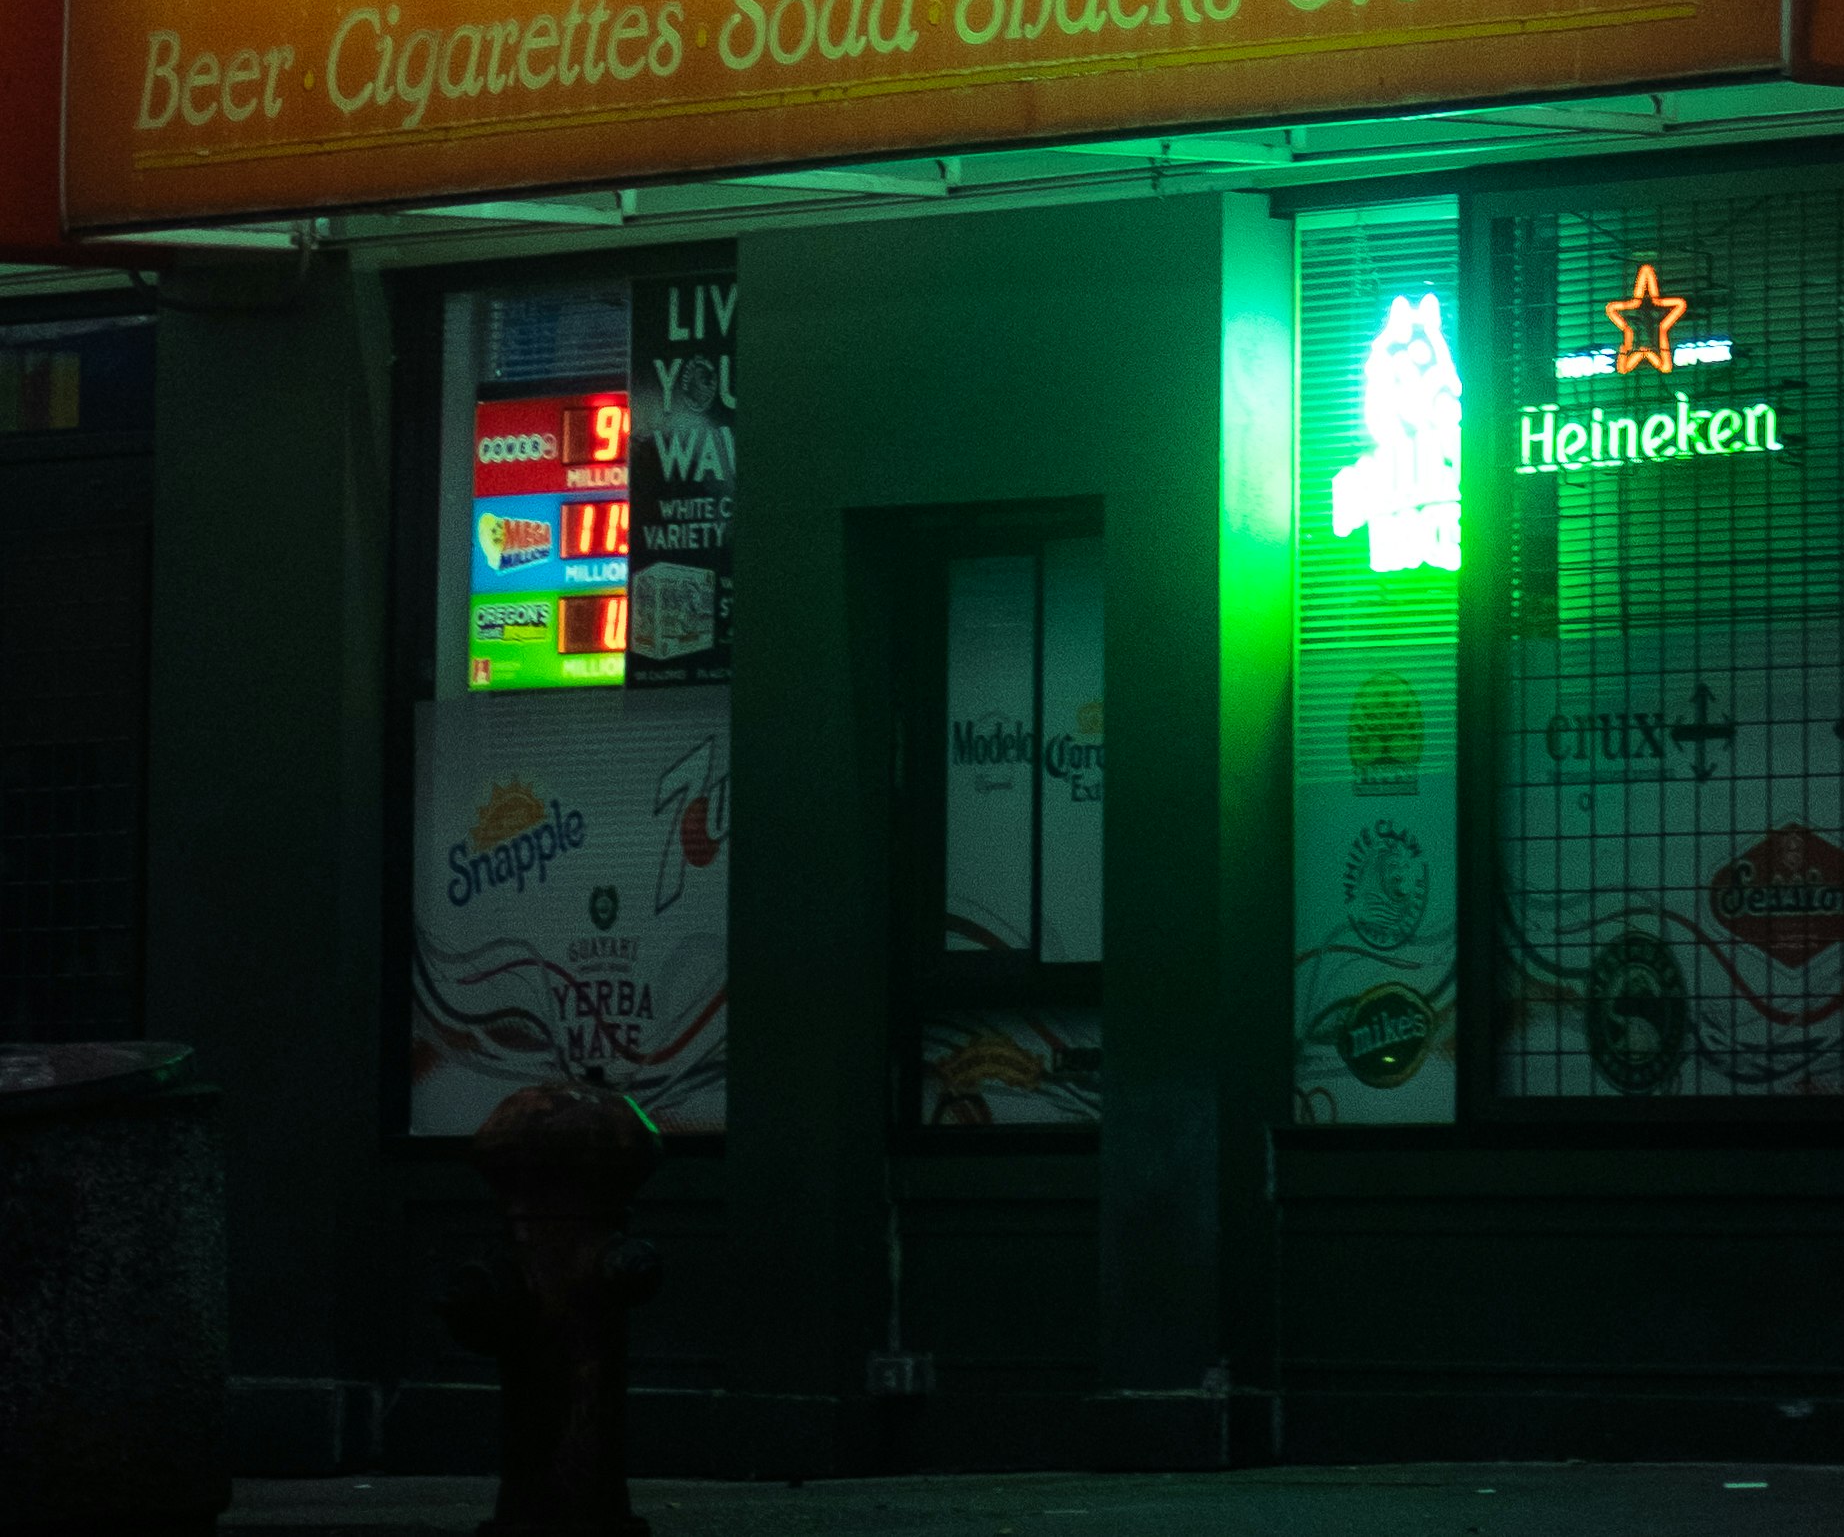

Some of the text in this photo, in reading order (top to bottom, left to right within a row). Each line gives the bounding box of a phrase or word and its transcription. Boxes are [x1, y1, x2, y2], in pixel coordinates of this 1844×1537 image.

[137, 28, 294, 129] Beer
[1515, 391, 1783, 474] Heineken
[643, 523, 727, 551] VARIETY
[659, 497, 715, 521] WHITE
[448, 799, 585, 906] Snapple
[552, 979, 654, 1021] YERBA
